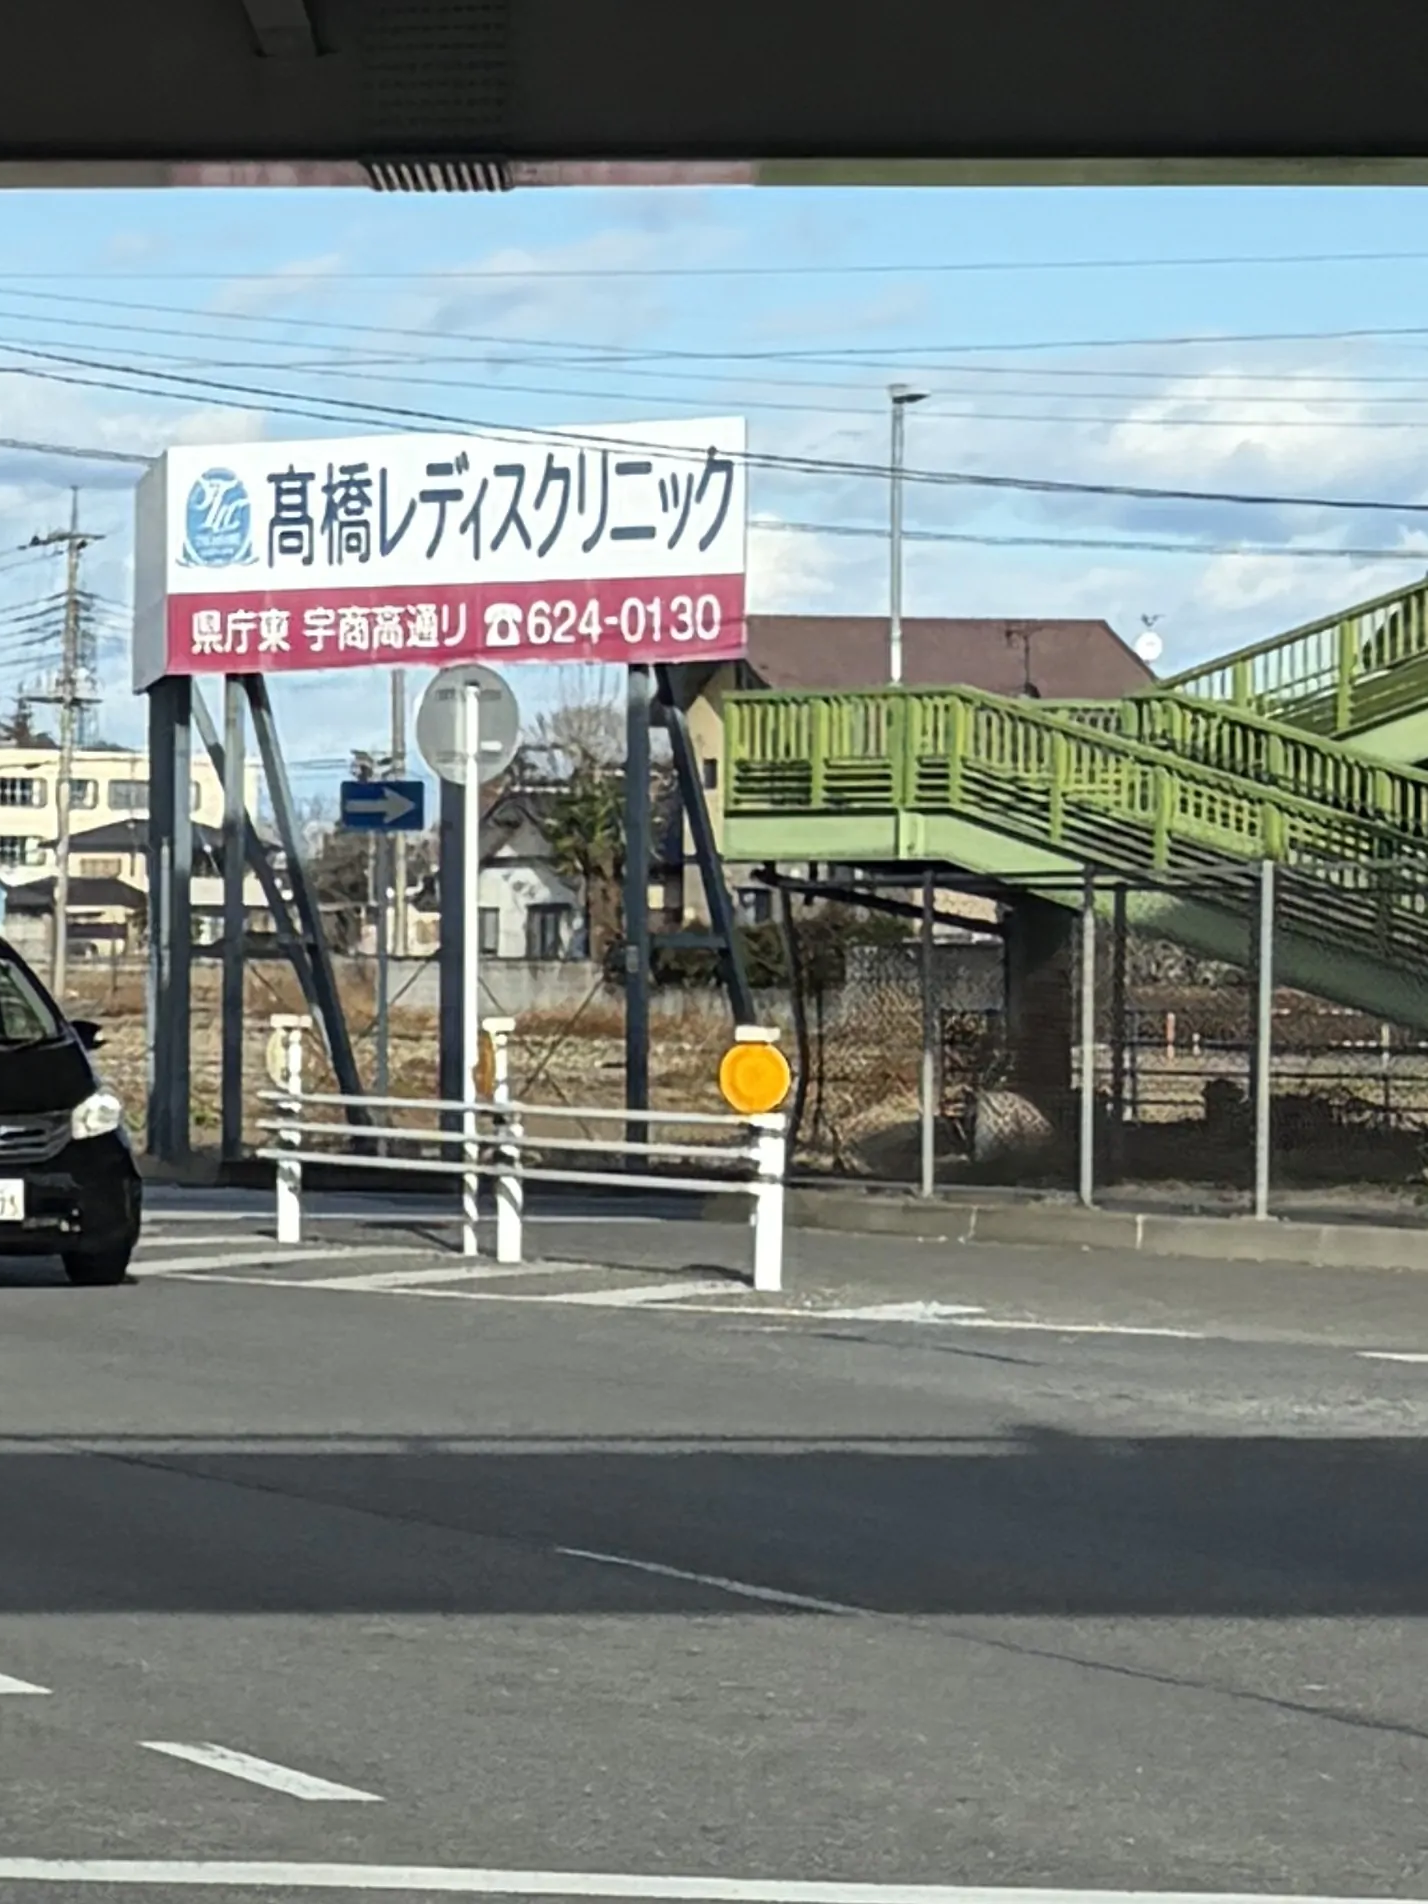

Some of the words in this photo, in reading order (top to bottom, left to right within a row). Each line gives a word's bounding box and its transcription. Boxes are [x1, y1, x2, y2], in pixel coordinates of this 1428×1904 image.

[191, 608, 292, 654] 県庁東
[527, 594, 722, 644] 624-0130
